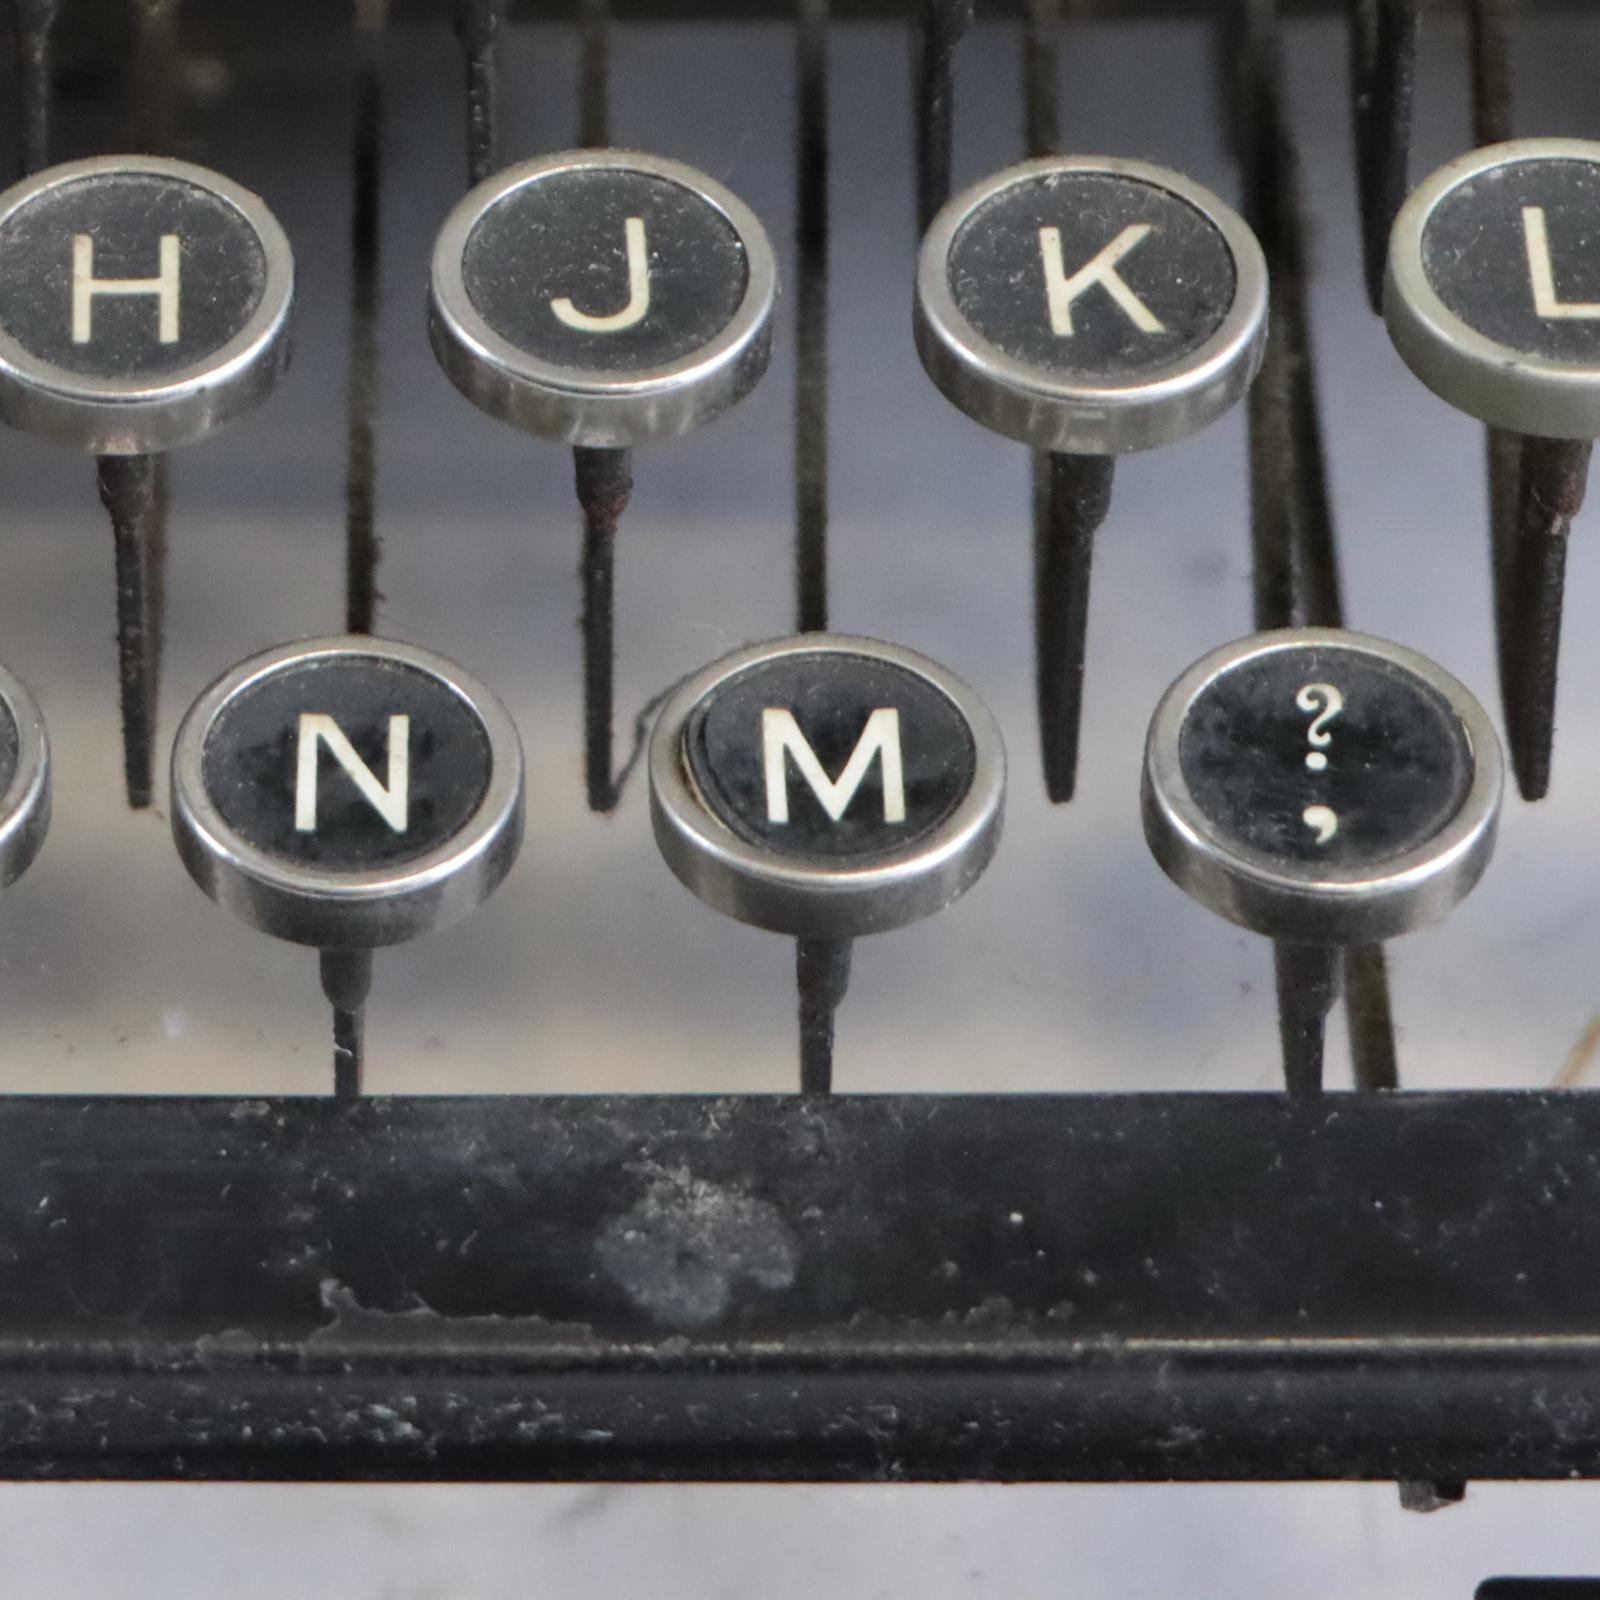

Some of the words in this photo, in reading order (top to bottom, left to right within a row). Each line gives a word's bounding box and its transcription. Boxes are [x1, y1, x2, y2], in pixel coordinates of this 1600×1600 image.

[71, 233, 181, 345] H
[549, 216, 654, 334] J
[1037, 223, 1166, 338] K
[1520, 206, 1600, 321] L
[294, 712, 411, 833] N
[761, 706, 906, 825] M
[1294, 681, 1347, 772] ?
[1301, 804, 1339, 844] ,
